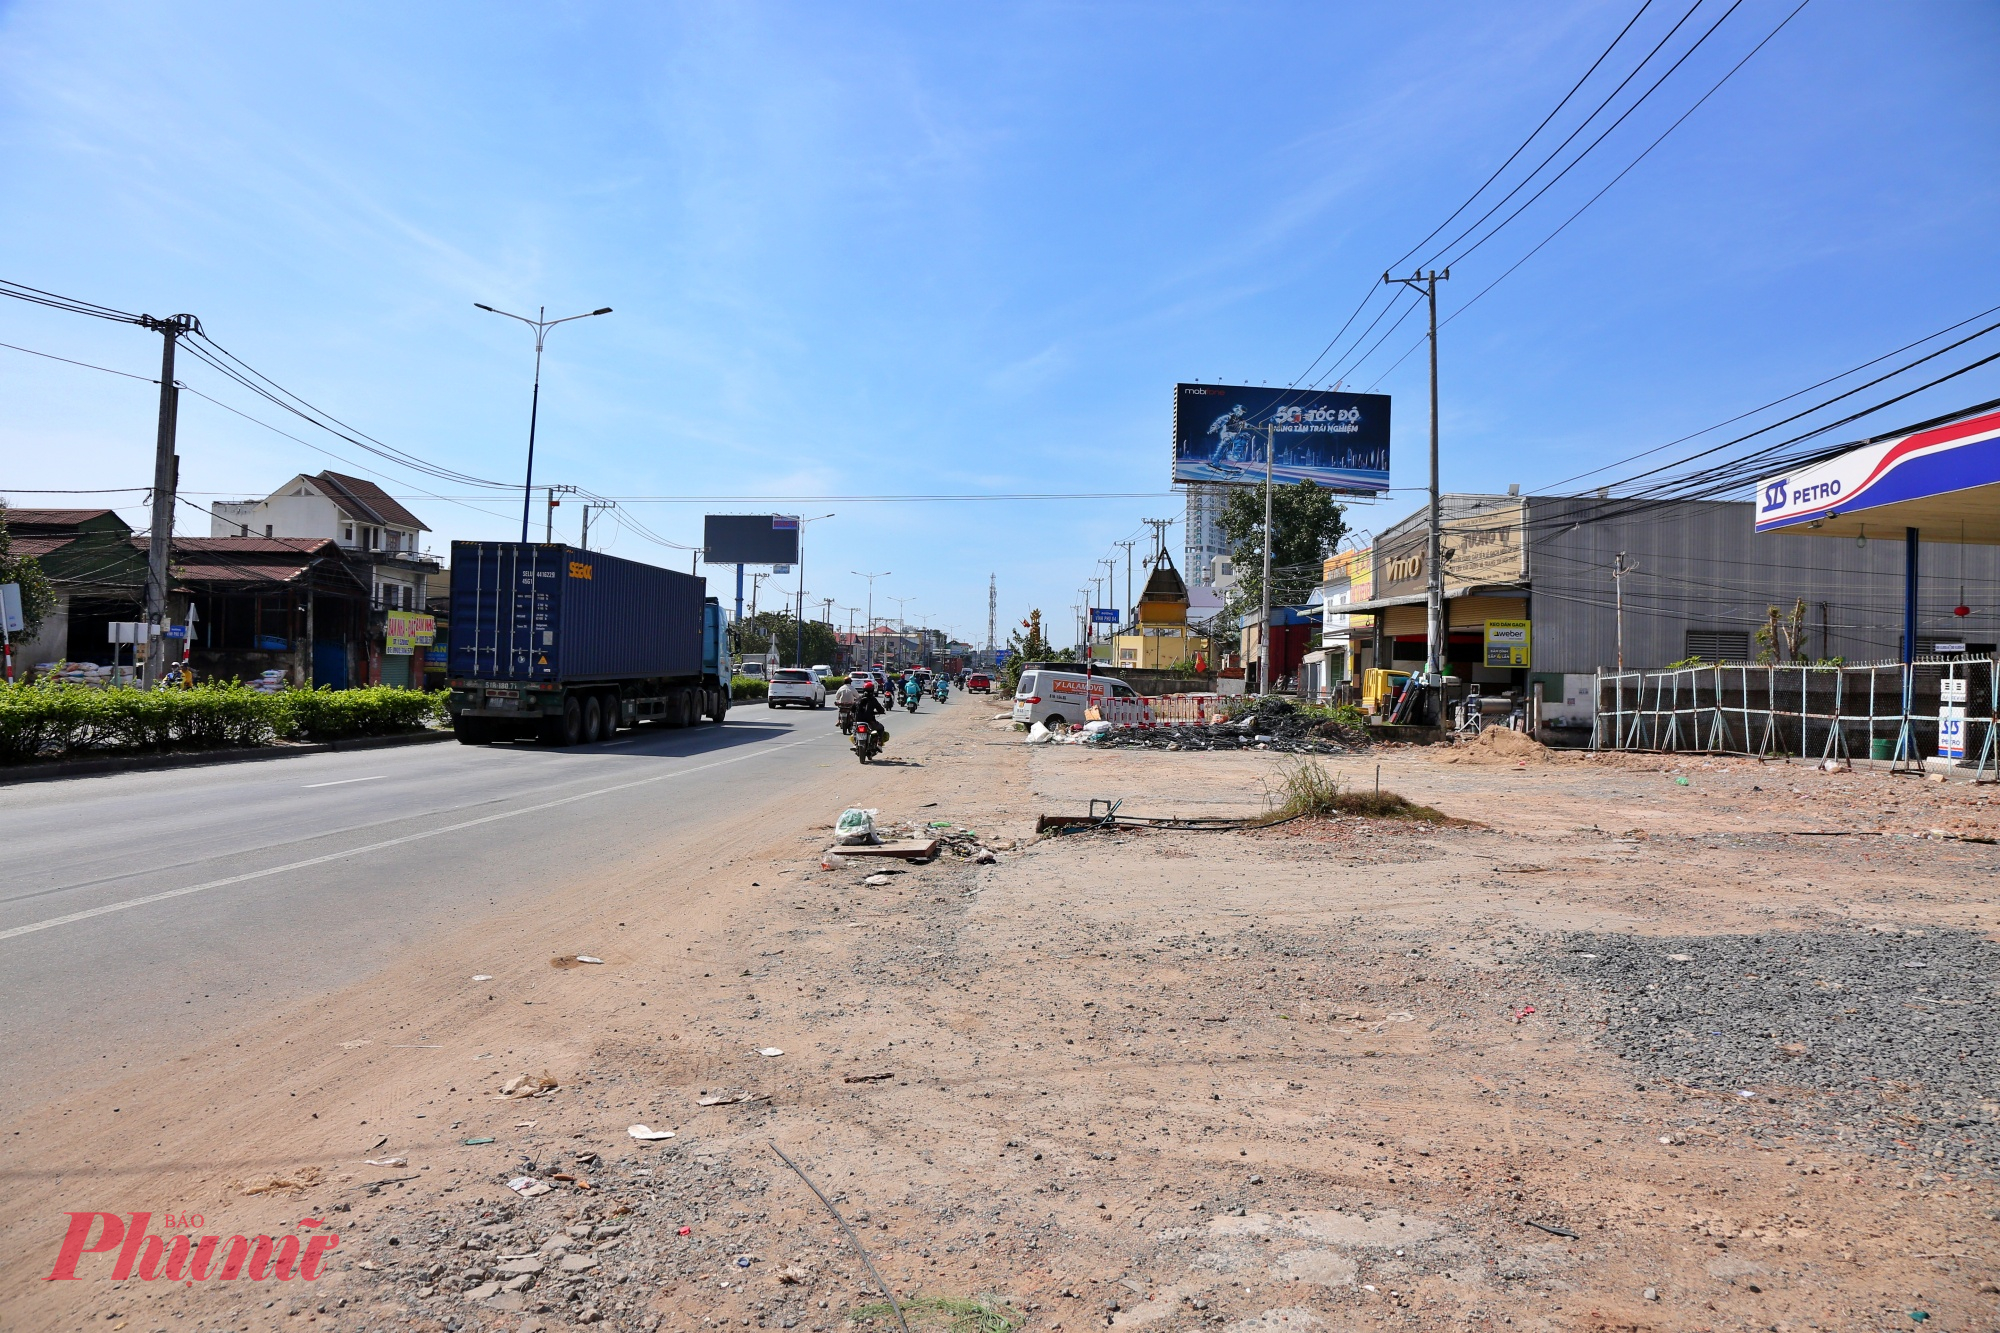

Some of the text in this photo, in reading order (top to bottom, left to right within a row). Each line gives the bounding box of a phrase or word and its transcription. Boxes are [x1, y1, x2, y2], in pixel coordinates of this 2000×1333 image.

[1184, 387, 1226, 396] mobifone
[1275, 406, 1302, 424] 5G
[1793, 479, 1841, 505] PETRO
[1499, 630, 1523, 638] weber
